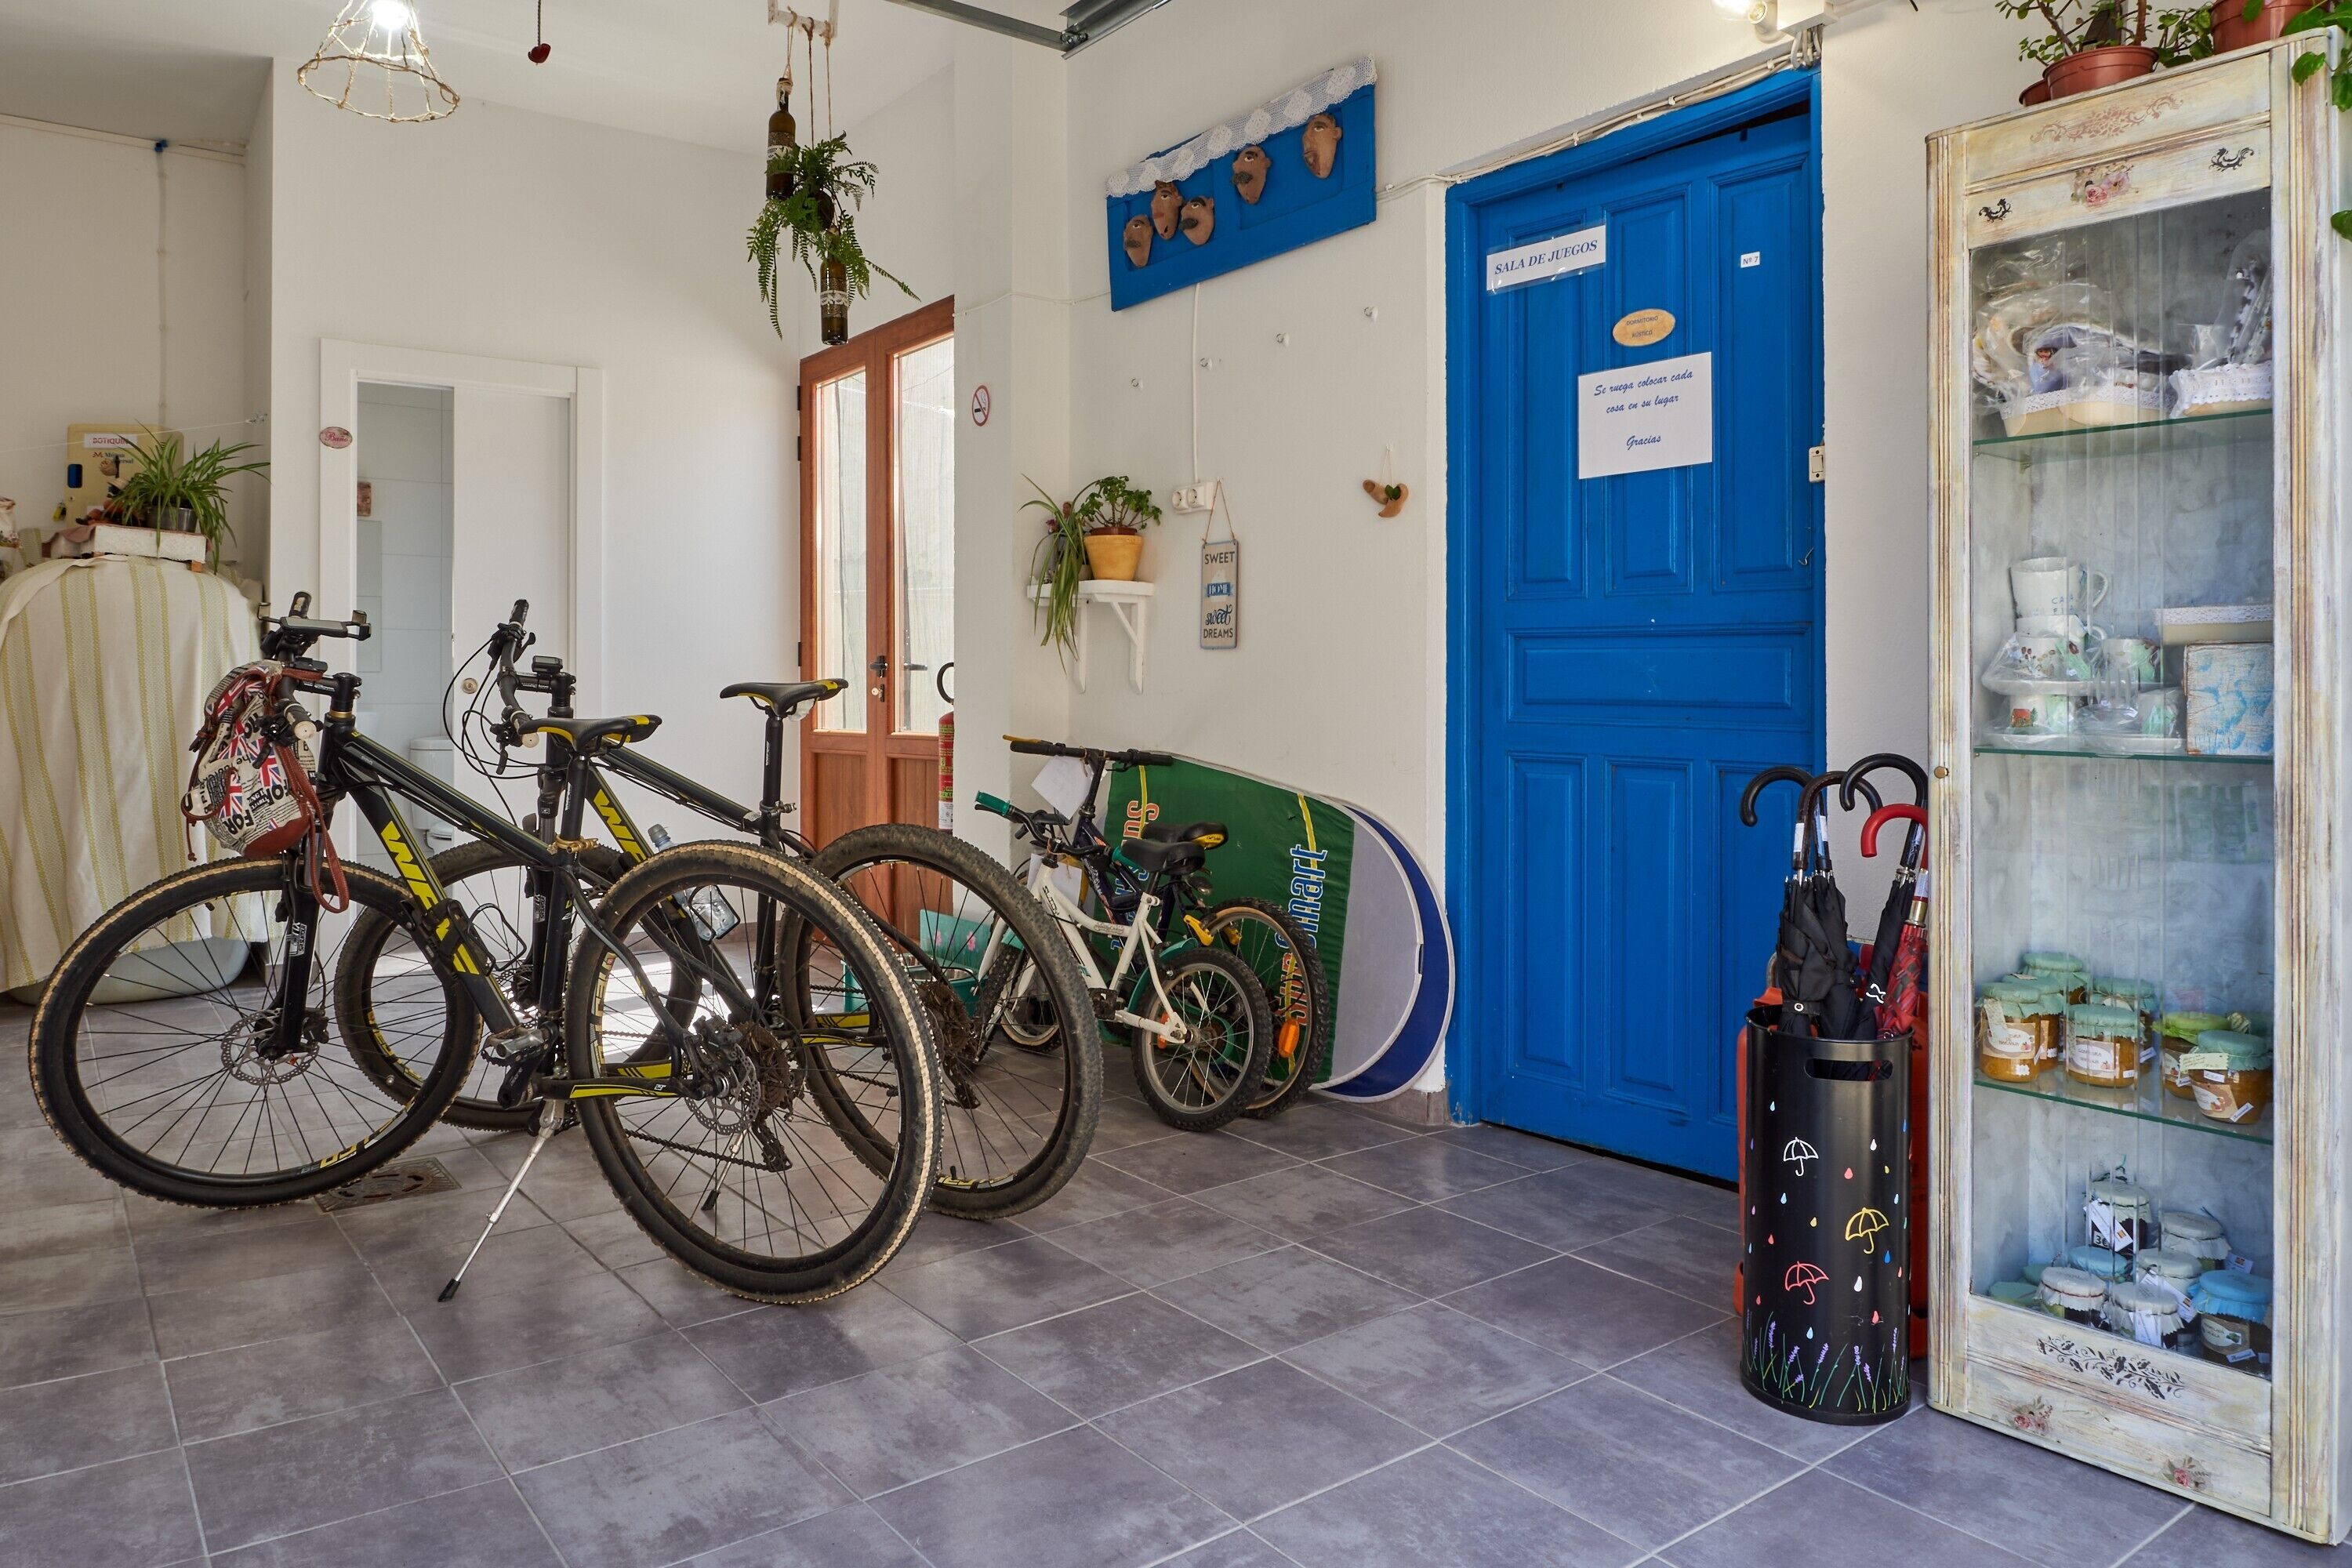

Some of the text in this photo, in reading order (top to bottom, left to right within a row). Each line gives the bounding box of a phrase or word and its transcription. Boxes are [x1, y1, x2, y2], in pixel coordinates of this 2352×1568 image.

[1495, 240, 1598, 274] SALA DE JUEGOS
[1626, 315, 1659, 326] DORMITORIO
[1594, 368, 1693, 396] Se ruega colocar cada
[1606, 404, 1624, 414] cosa
[1641, 399, 1652, 408] su
[1654, 394, 1679, 408] lugar
[1626, 434, 1662, 451] Gracias
[1204, 551, 1235, 564] SWEET
[1208, 584, 1229, 595] HOME
[1205, 604, 1232, 626] sweet
[1203, 628, 1233, 638] DREAMS
